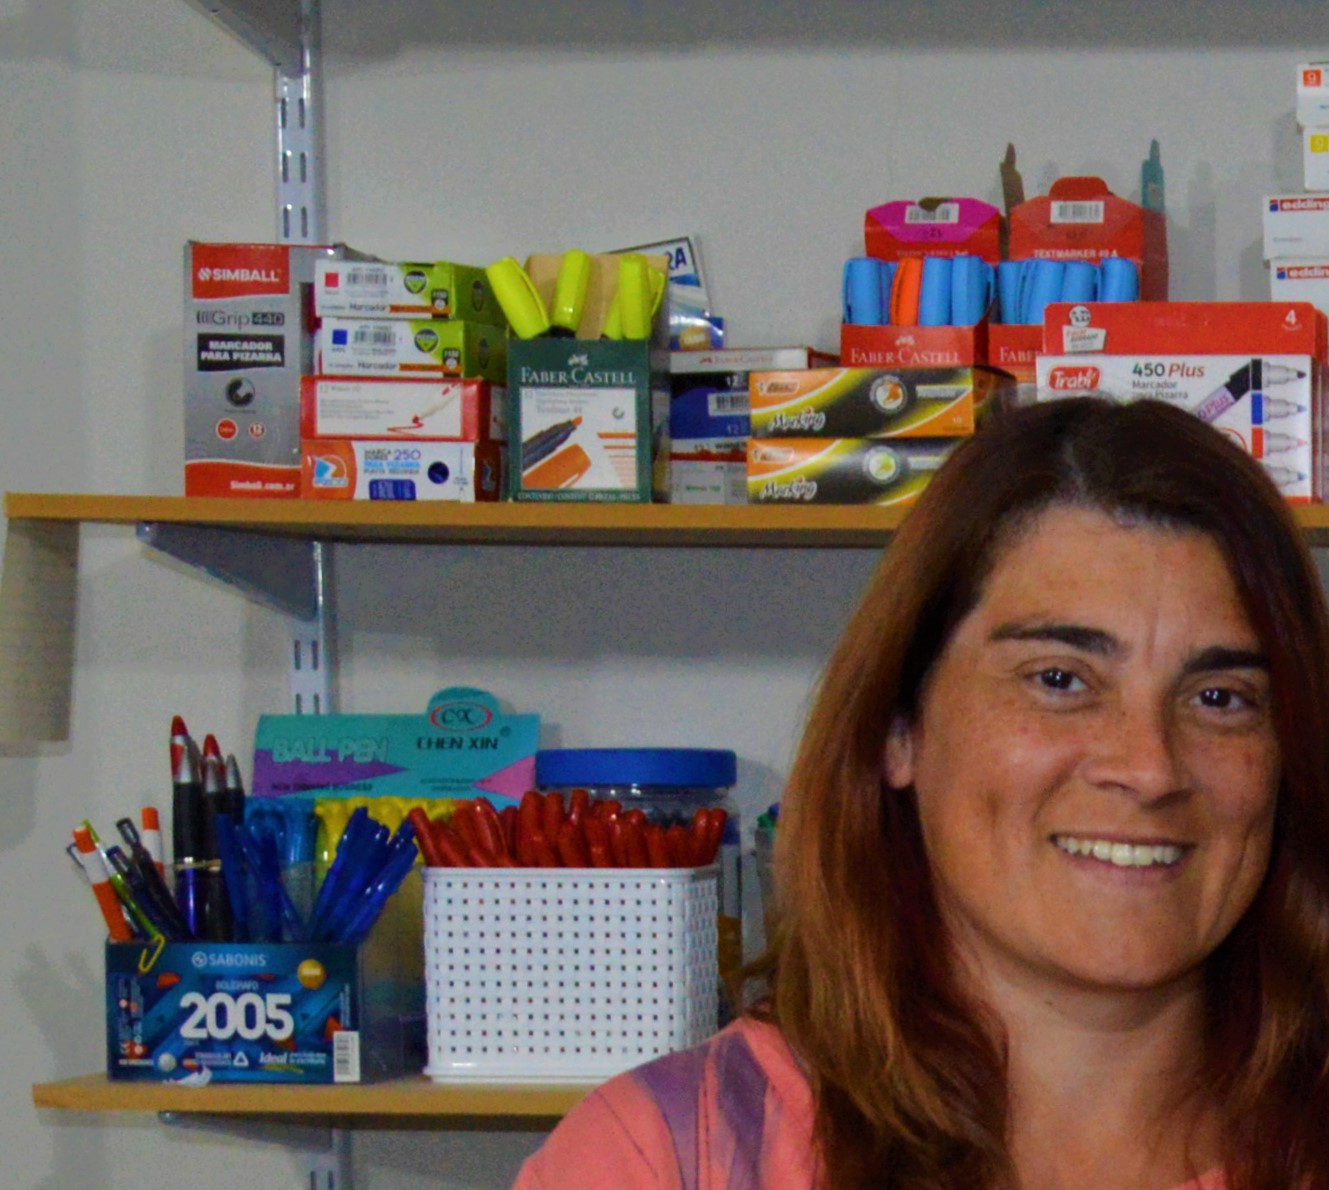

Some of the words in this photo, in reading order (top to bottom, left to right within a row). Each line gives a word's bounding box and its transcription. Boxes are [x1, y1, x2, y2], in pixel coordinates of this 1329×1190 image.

[213, 268, 279, 282] SIMBALL
[212, 311, 250, 329] Grip
[252, 313, 284, 325] 440
[1285, 310, 1296, 325] 4
[209, 340, 273, 351] MARCADOR
[201, 351, 231, 361] PARA
[233, 351, 282, 362] PIZARRA
[851, 349, 960, 364] FABER-CASTELL
[521, 368, 636, 384] FABER-CASTELL
[1132, 363, 1165, 377] 450
[1168, 362, 1205, 378] Plus
[1053, 369, 1096, 390] Trabi
[1132, 380, 1178, 390] Marcador
[417, 737, 464, 750] CHEN
[468, 737, 498, 750] XIN
[209, 953, 267, 967] SABONIS
[179, 991, 295, 1040] 2005
[260, 1051, 288, 1065] Ideal
